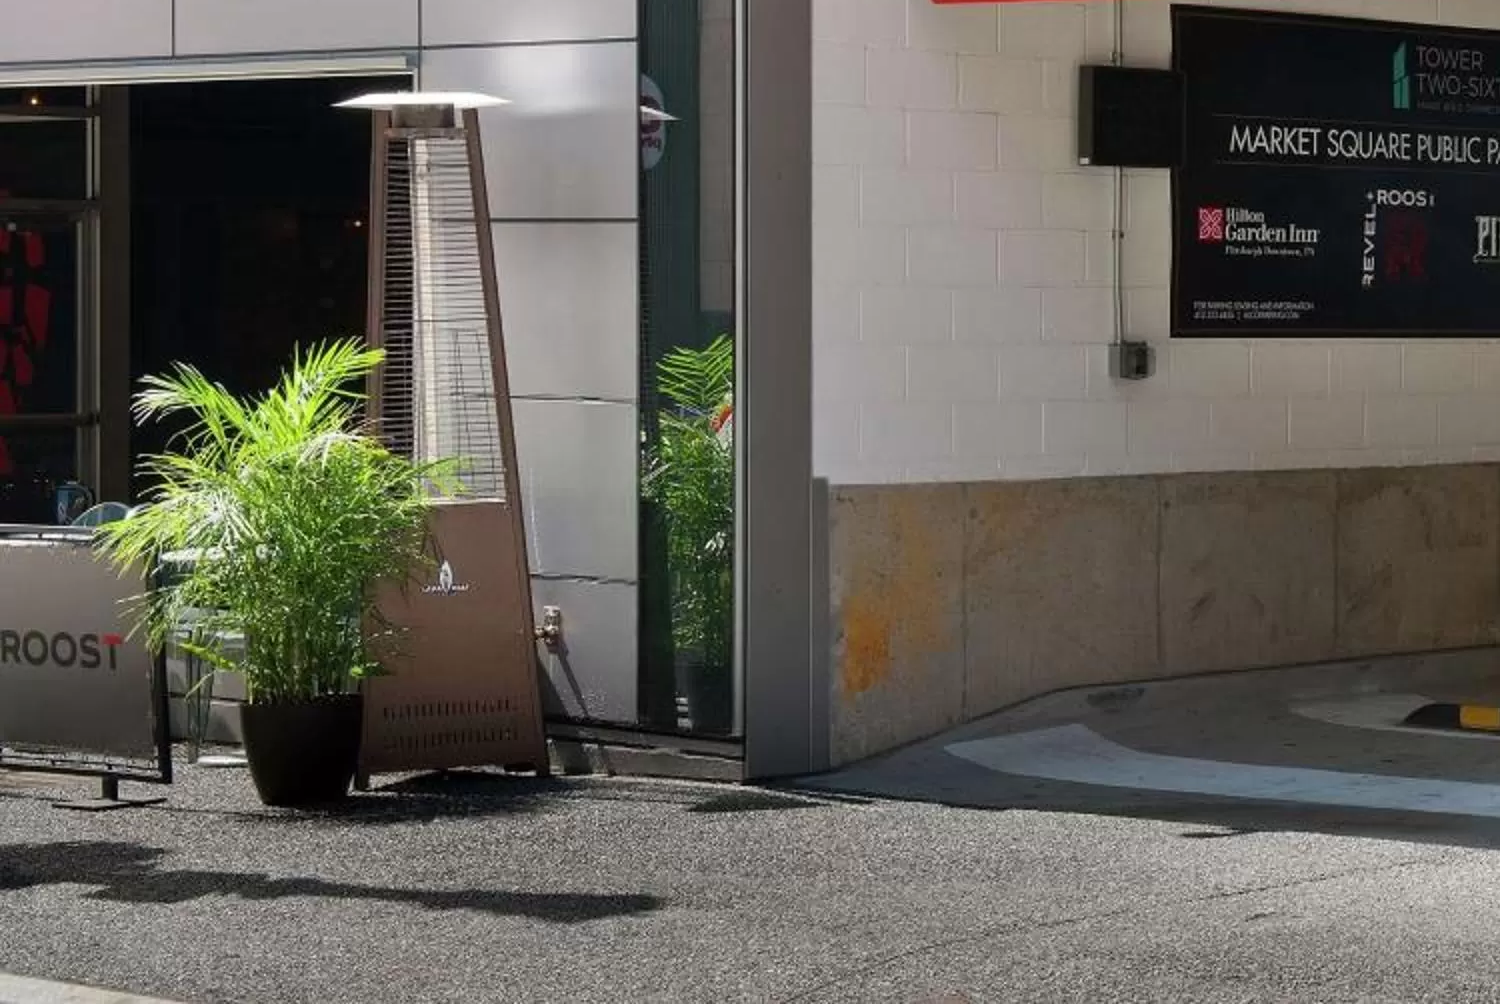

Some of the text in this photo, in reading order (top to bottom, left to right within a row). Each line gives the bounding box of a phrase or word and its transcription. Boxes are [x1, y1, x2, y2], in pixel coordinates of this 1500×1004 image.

[1415, 45, 1484, 72] TOWER
[1229, 124, 1322, 156] MARKET
[1327, 128, 1412, 161] SQUARE
[1417, 133, 1481, 164] PUBLIC
[1225, 207, 1265, 223] Hilton
[1225, 222, 1319, 243] Garden Inn
[1361, 203, 1376, 289] REVEL
[0, 629, 123, 671] ROOST
